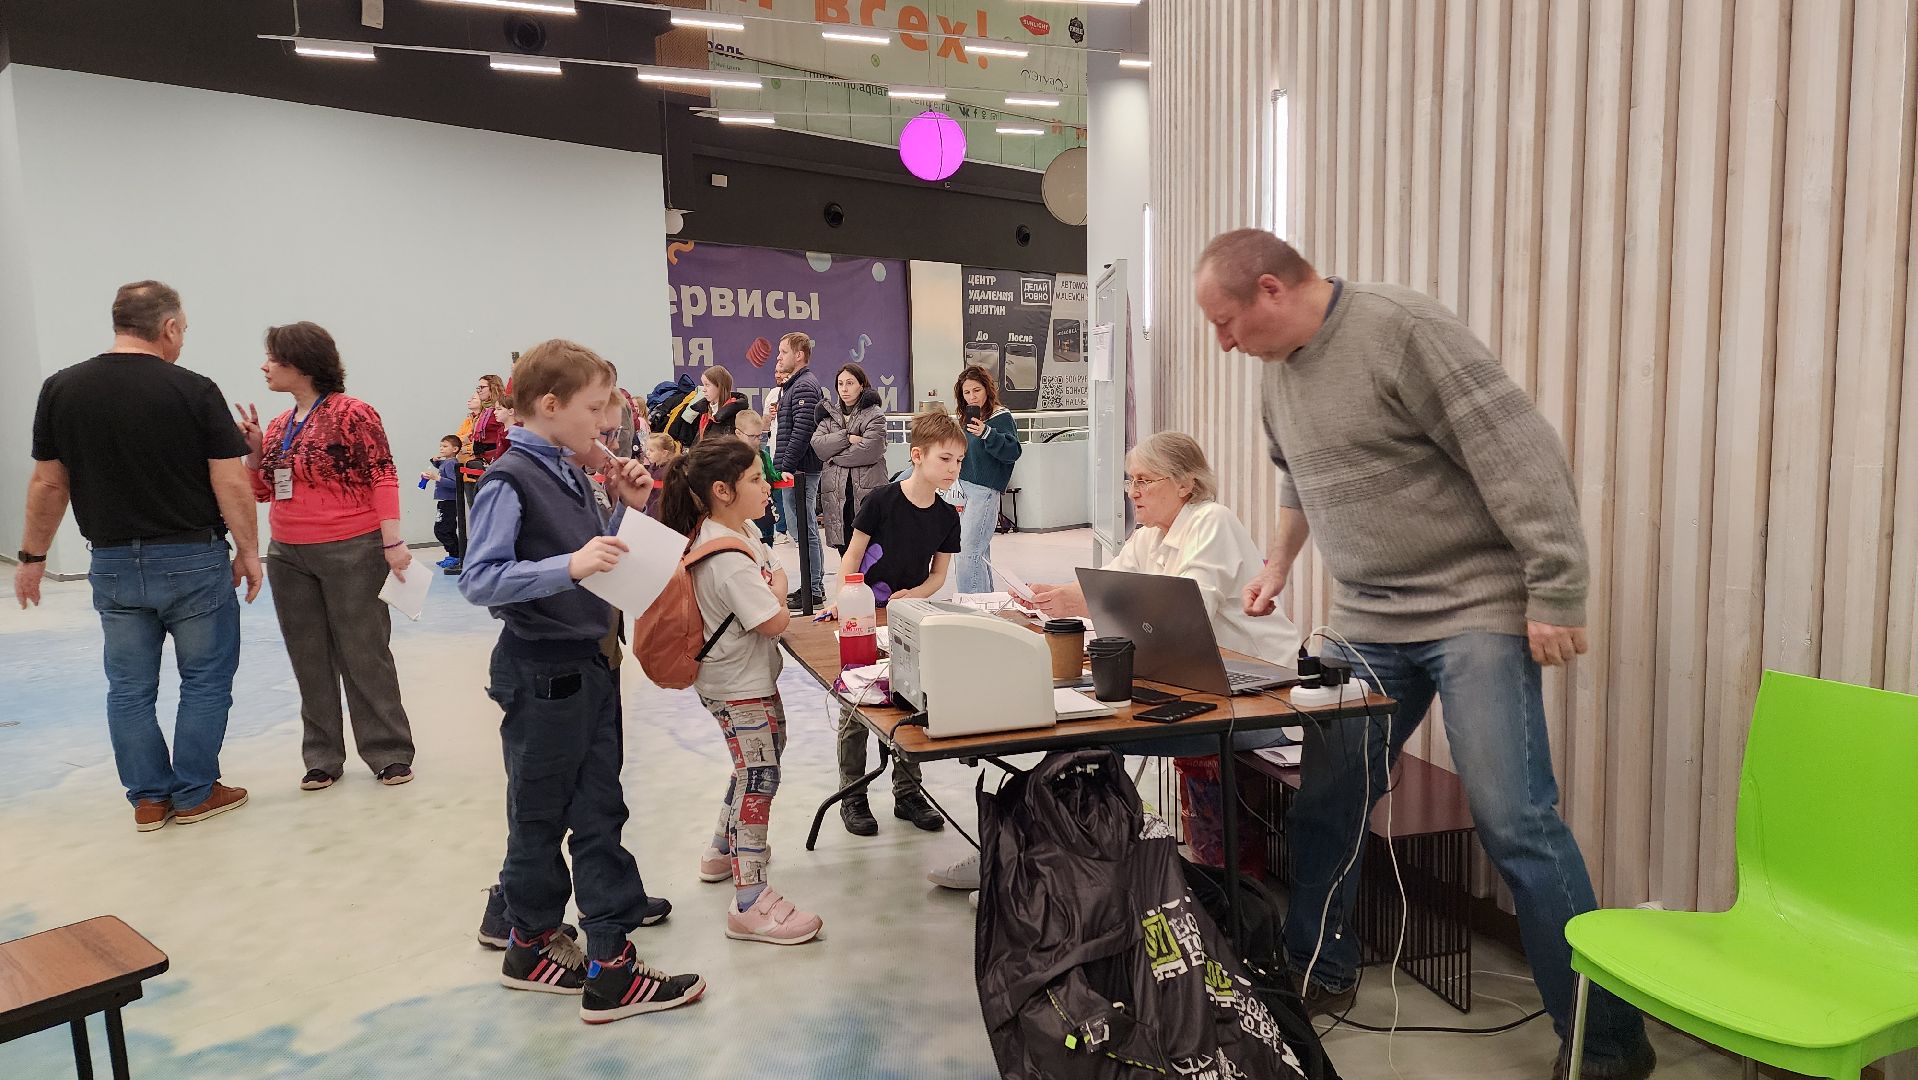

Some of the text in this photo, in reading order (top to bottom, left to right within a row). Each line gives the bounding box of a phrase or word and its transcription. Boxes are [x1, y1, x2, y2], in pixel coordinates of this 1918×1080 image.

[1023, 20, 1049, 31] SUNLIGHT
[968, 274, 997, 286] ЦЕНТР
[1023, 282, 1048, 293] ДЕЛАЙ
[968, 289, 1014, 302] УДАЛЕНИЯ
[1024, 292, 1049, 301] РОВНО
[968, 304, 1006, 316] ВМЯТИН
[976, 330, 989, 342] До
[1007, 332, 1034, 343] После
